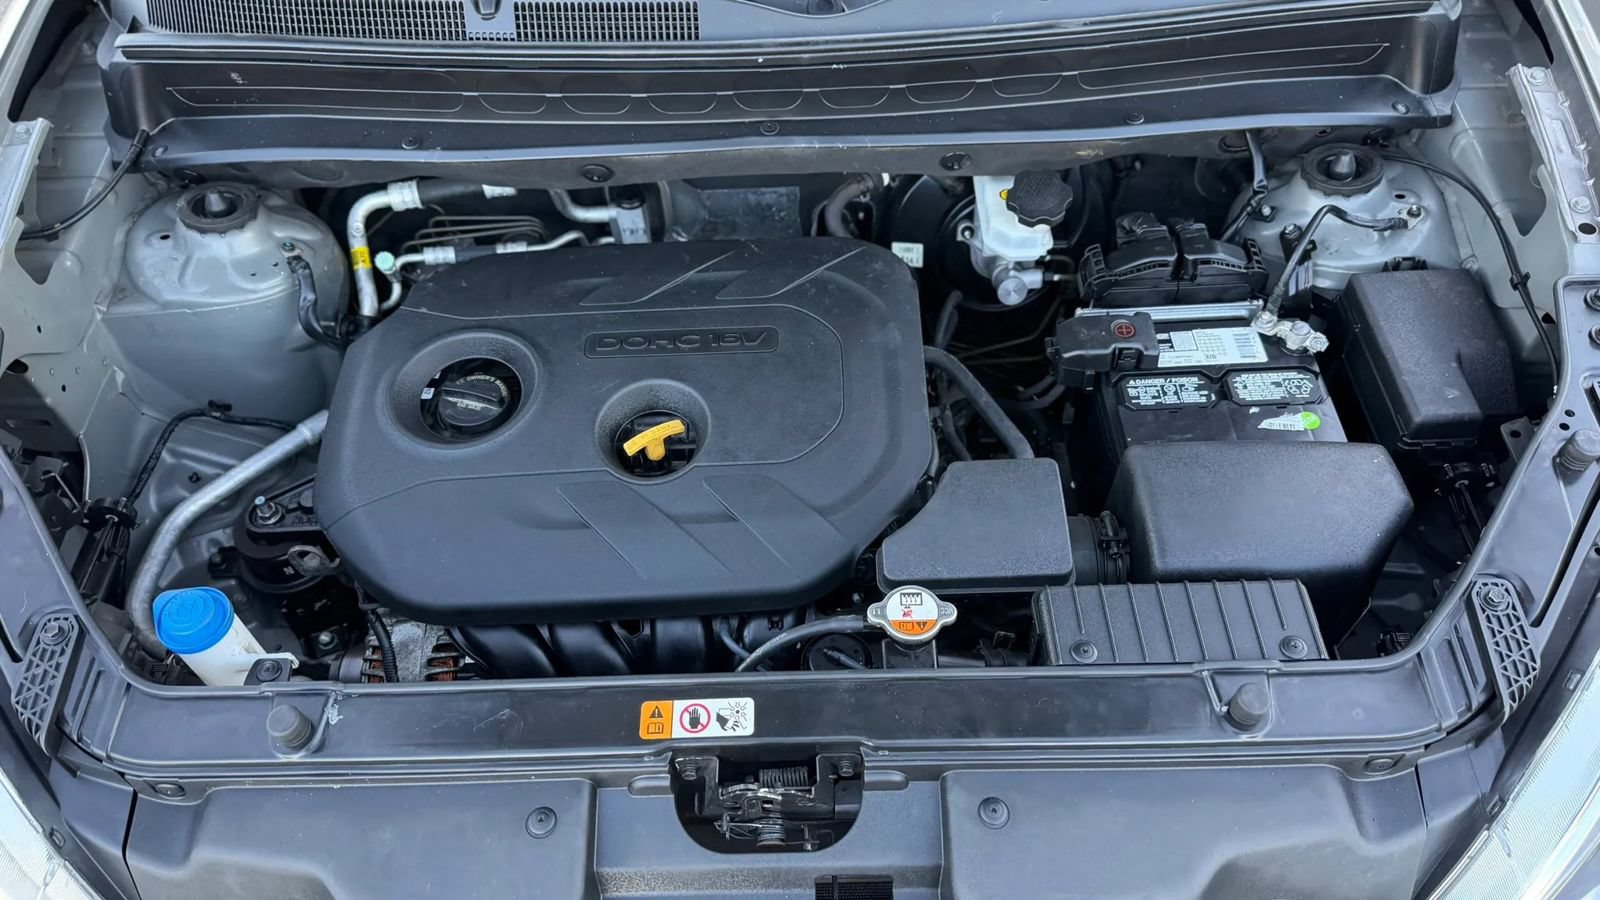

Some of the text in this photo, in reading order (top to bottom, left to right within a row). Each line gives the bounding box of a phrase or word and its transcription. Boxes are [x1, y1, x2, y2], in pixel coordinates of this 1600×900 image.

[596, 331, 767, 351] DOHC 16V
[1171, 376, 1199, 384] POISON
